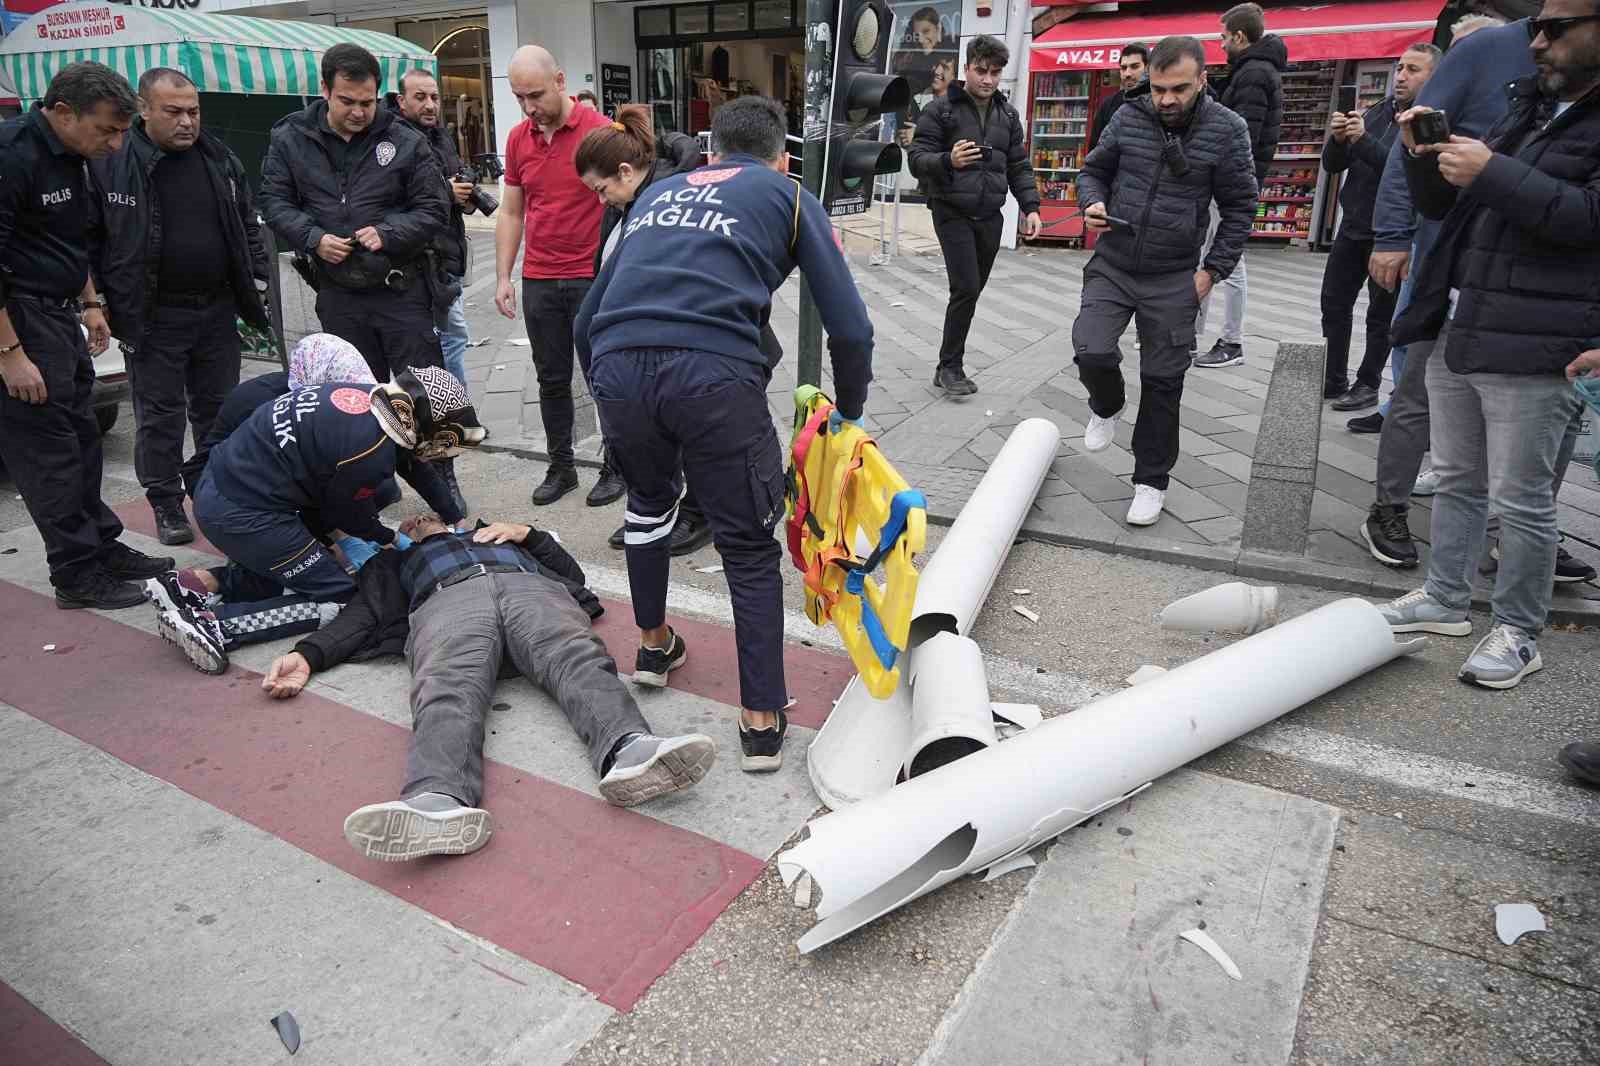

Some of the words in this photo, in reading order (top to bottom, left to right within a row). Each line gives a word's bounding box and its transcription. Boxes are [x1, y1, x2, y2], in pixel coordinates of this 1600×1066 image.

[46, 10, 81, 26] BURSA'NIN
[82, 7, 111, 24] MEŞHUR
[49, 28, 82, 40] KAZAN
[83, 22, 114, 37] SİMİDİ
[1056, 49, 1104, 65] AYAZ
[650, 184, 723, 206] ACİL
[623, 204, 739, 239] SAĞLIK
